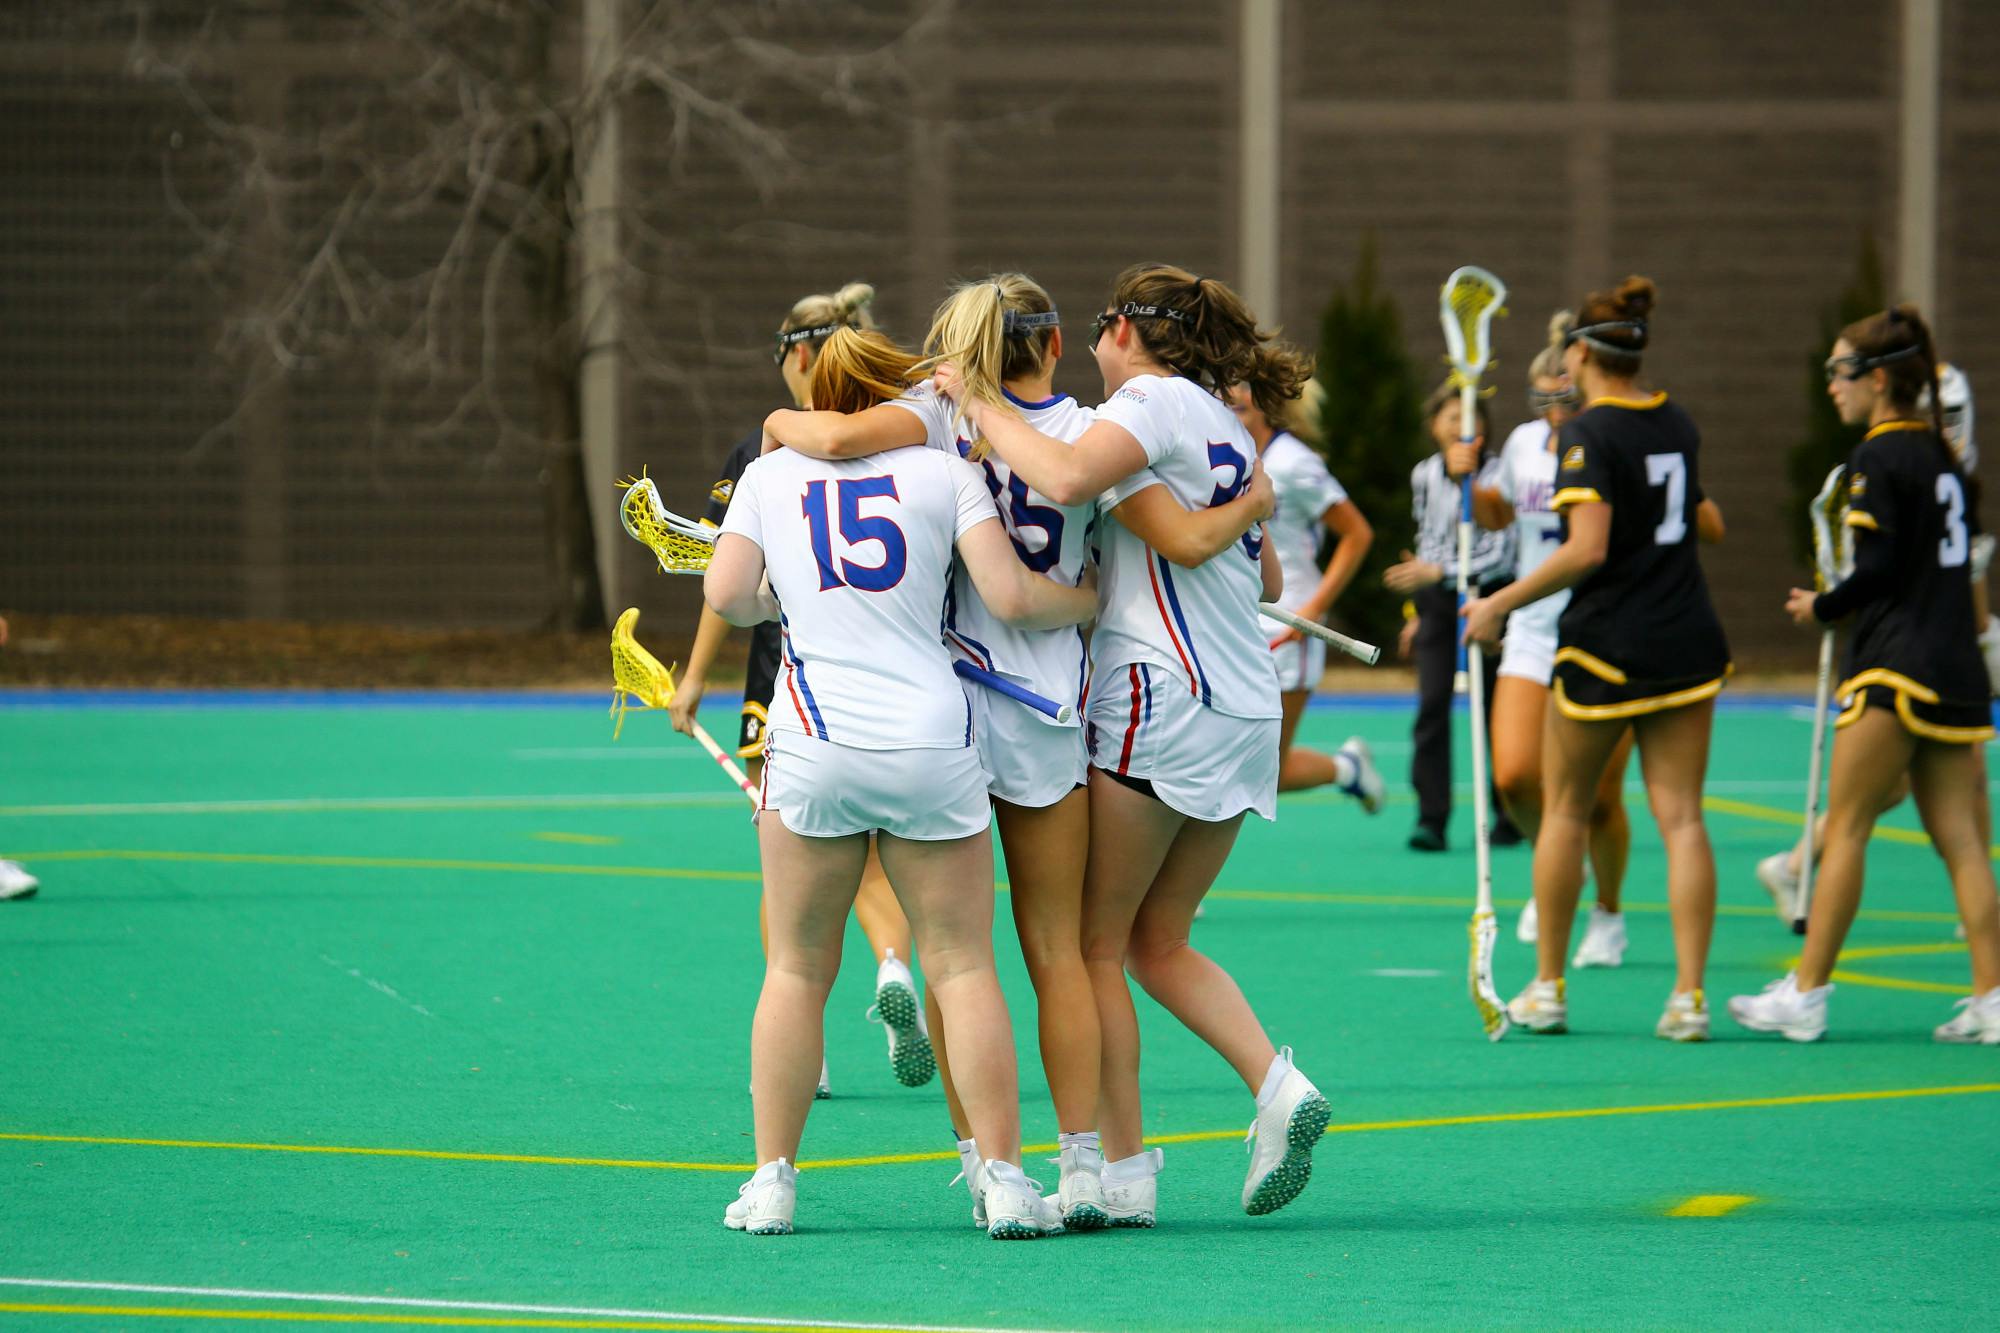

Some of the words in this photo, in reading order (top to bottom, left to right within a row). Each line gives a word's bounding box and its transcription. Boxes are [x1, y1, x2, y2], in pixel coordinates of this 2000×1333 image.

[801, 474, 907, 593] 15
[1645, 453, 1687, 545] 7
[1936, 473, 1968, 567] 3
